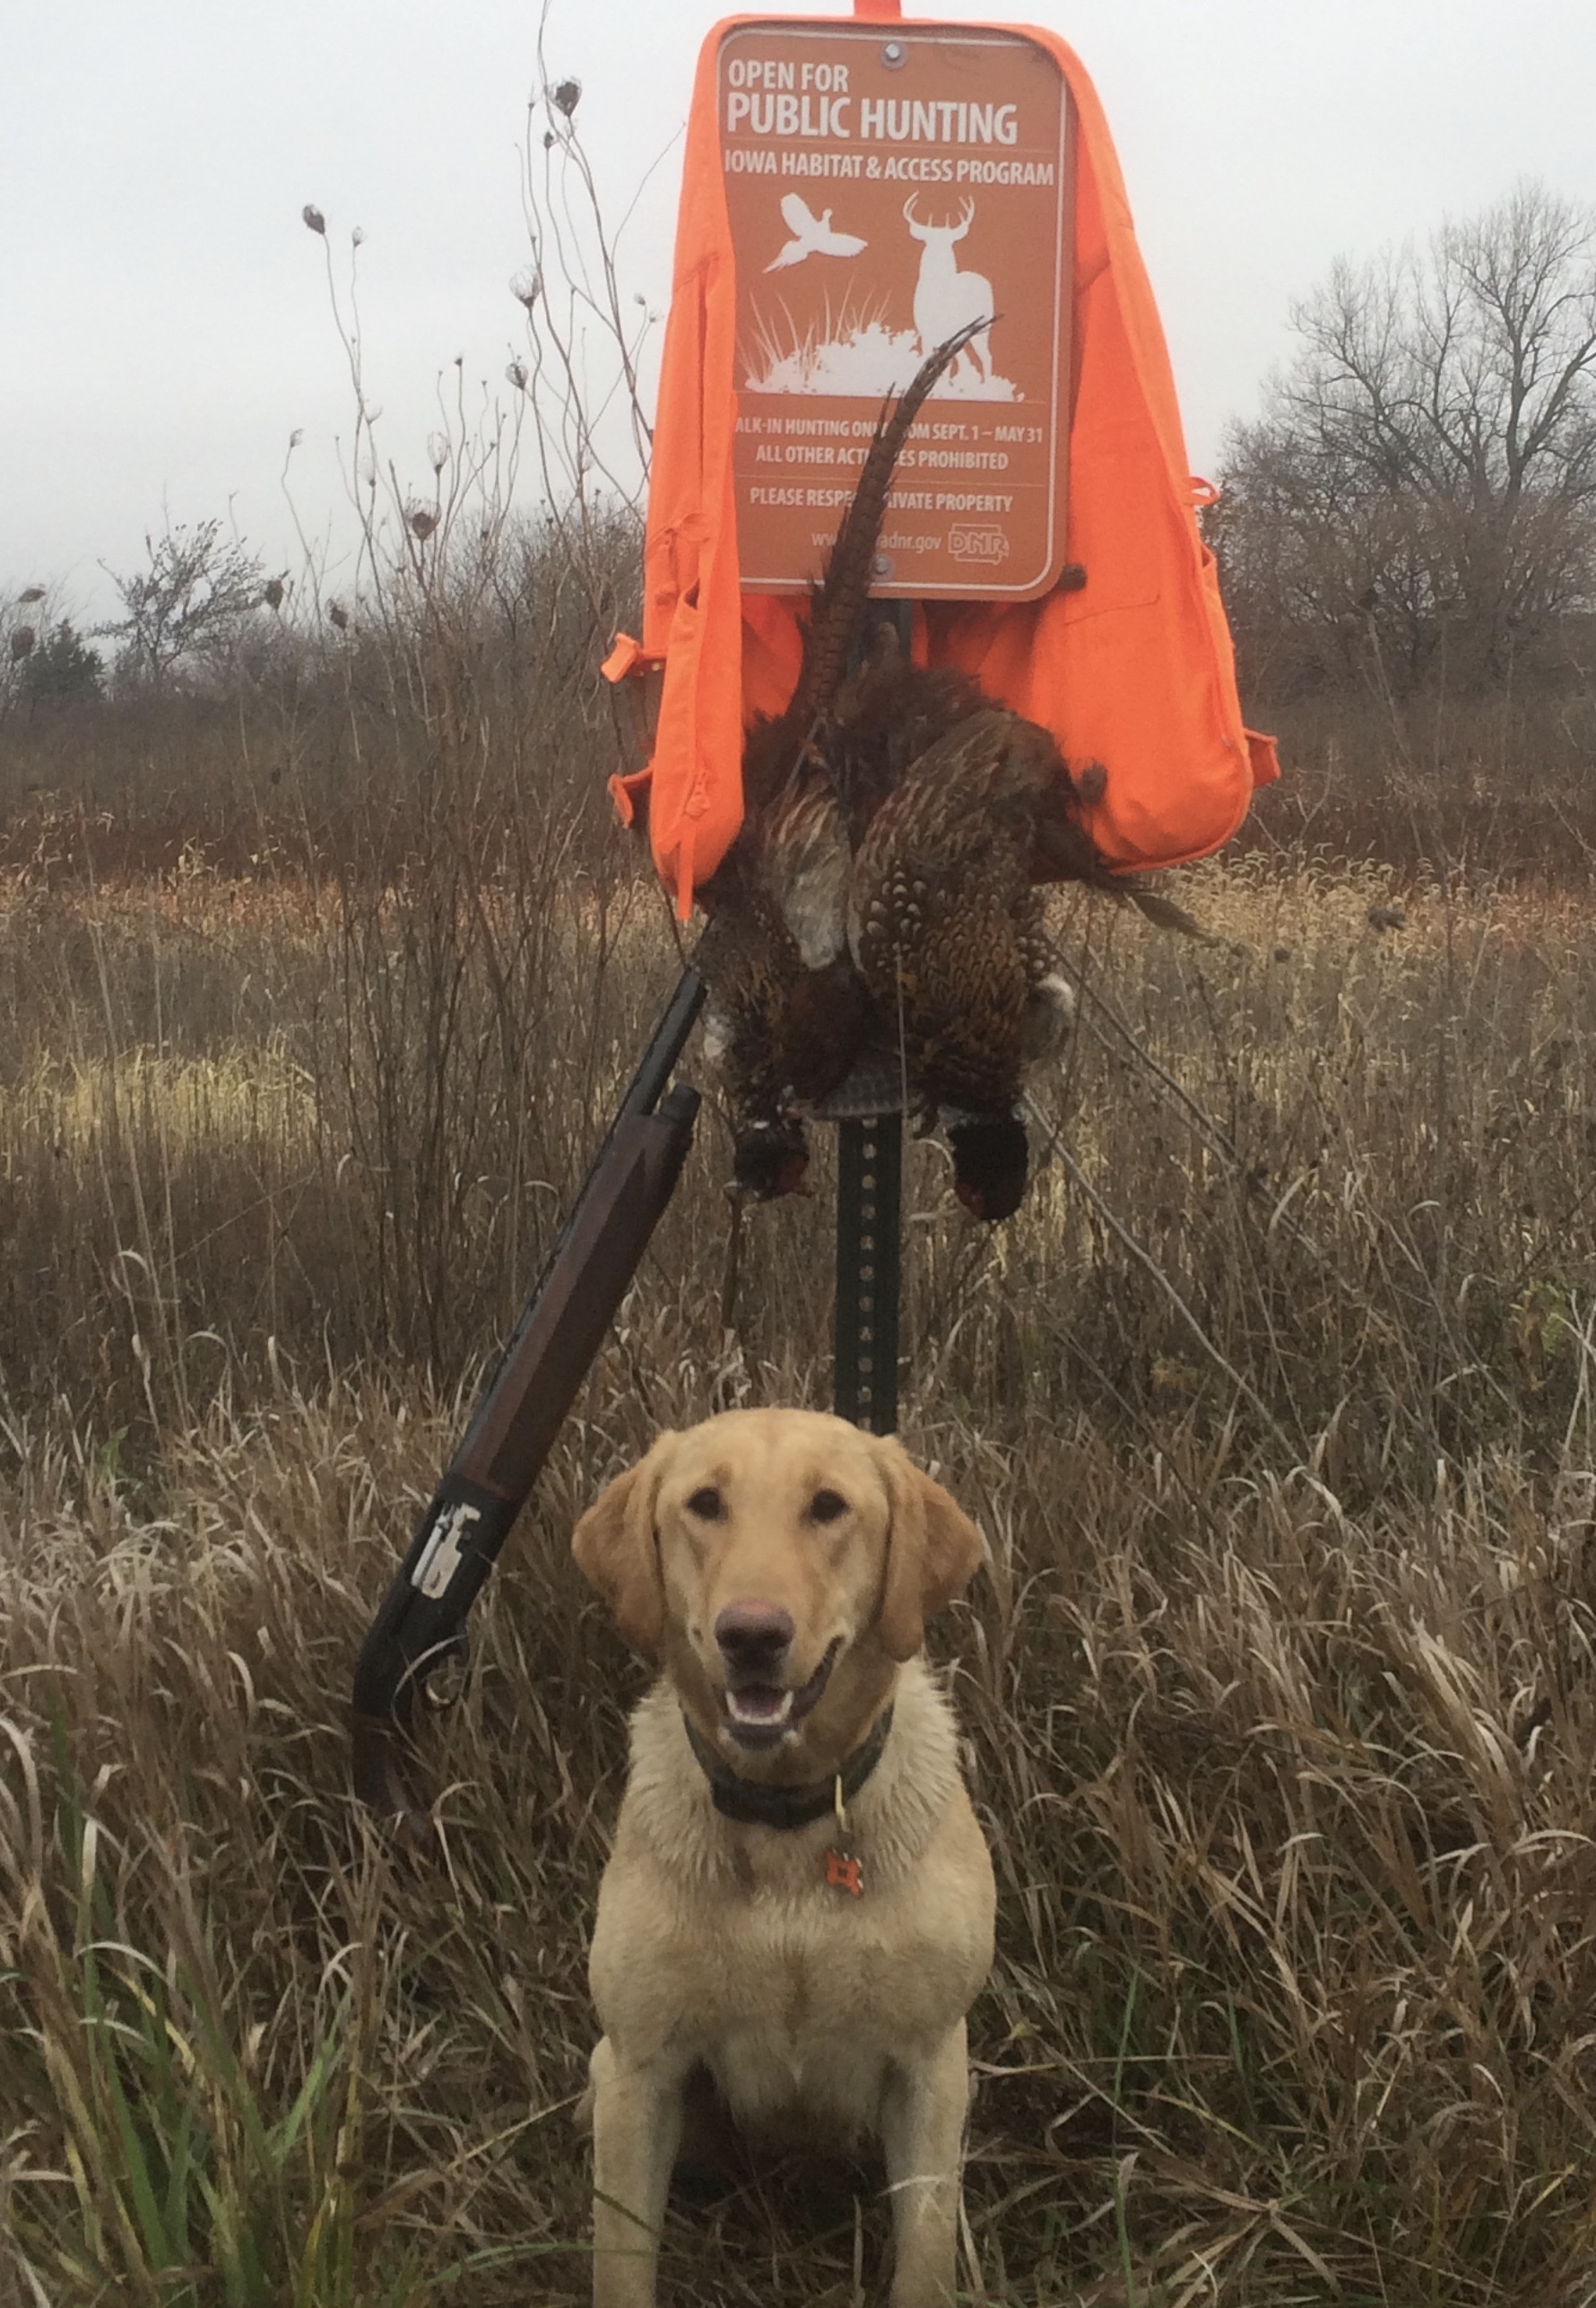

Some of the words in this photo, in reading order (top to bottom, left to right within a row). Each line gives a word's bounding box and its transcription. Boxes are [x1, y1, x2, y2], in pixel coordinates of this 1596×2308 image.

[728, 59, 794, 90] OPEN
[801, 62, 849, 92] FOR
[727, 92, 852, 138] PUBLIC
[861, 98, 1018, 145] HUNTING
[724, 150, 776, 175] IOWA
[782, 152, 863, 178] HABITAT
[865, 157, 881, 179] &
[883, 157, 953, 182] ACCESS
[957, 161, 1054, 187] PROGRAM
[735, 417, 783, 434] ALK-IN
[785, 419, 850, 437] HUNTING
[932, 423, 969, 441] SEPT.
[972, 425, 979, 441] 1
[994, 425, 1025, 442] MAY
[1027, 428, 1044, 444] 31
[755, 445, 783, 463] ALL
[785, 446, 835, 464] OTHER
[918, 450, 1009, 470] PROHIBITED
[750, 487, 804, 506] PLEASE
[935, 493, 1013, 513] PROPERTY
[947, 530, 1010, 558] DNR
